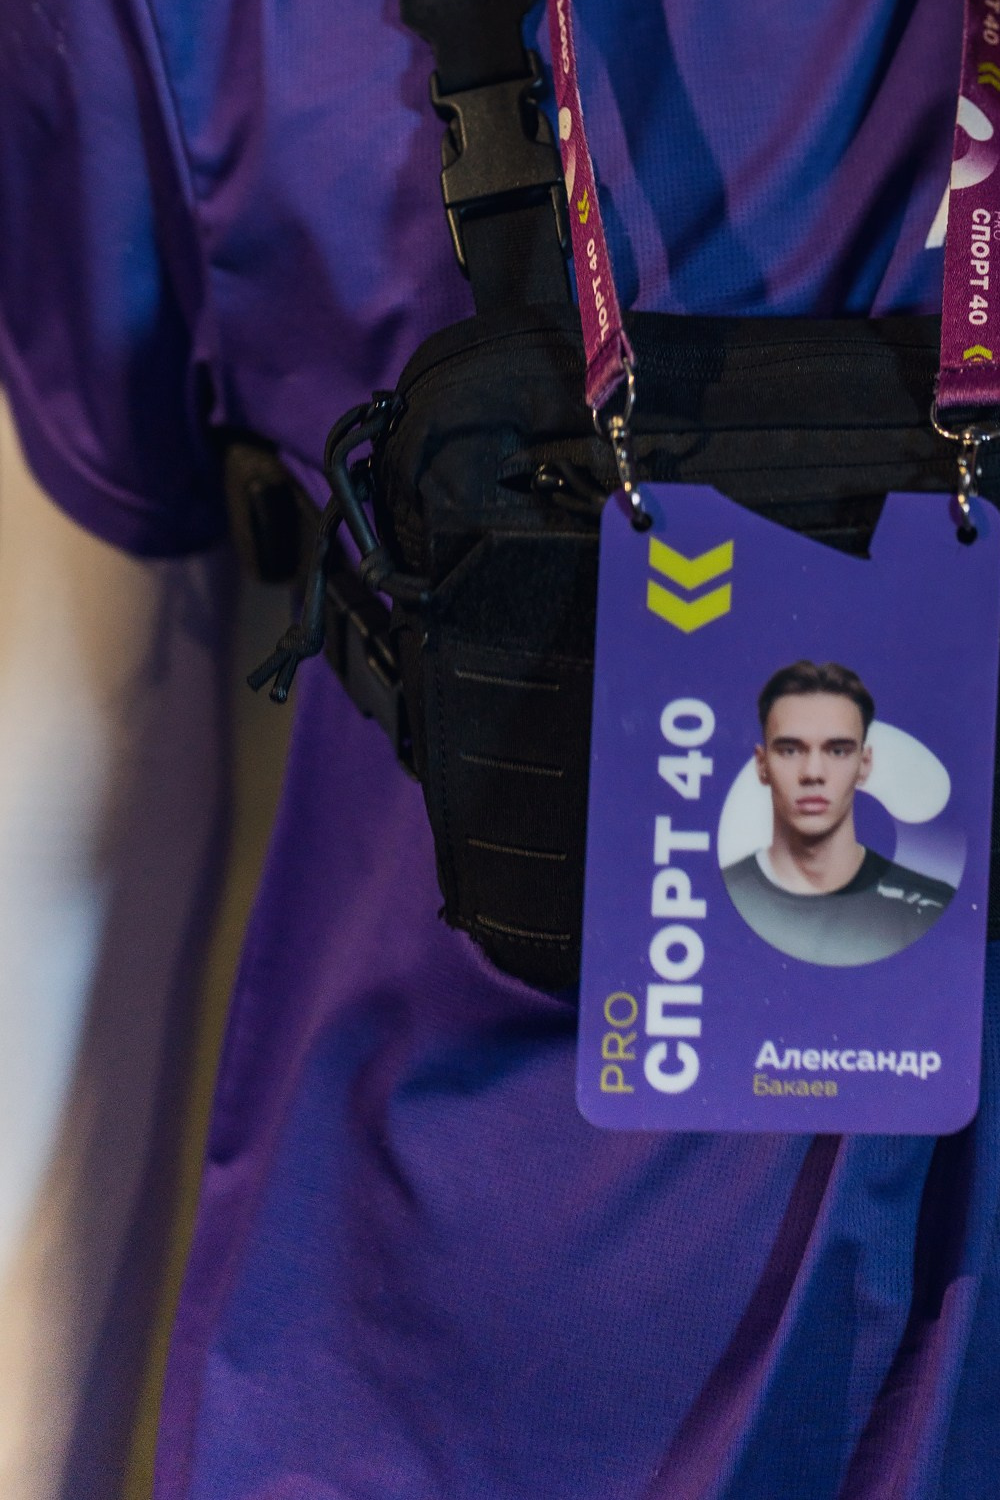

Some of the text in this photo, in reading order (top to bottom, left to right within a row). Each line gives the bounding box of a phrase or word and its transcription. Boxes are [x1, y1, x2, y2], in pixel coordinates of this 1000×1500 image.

[983, 14, 1000, 45] 40
[586, 238, 598, 270] 40
[968, 208, 991, 325] СПОРТ 40
[643, 698, 716, 1094] СПОРТ 40
[600, 991, 638, 1094] PRO
[755, 1040, 941, 1079] Александр
[752, 1074, 838, 1097] Бакаев
